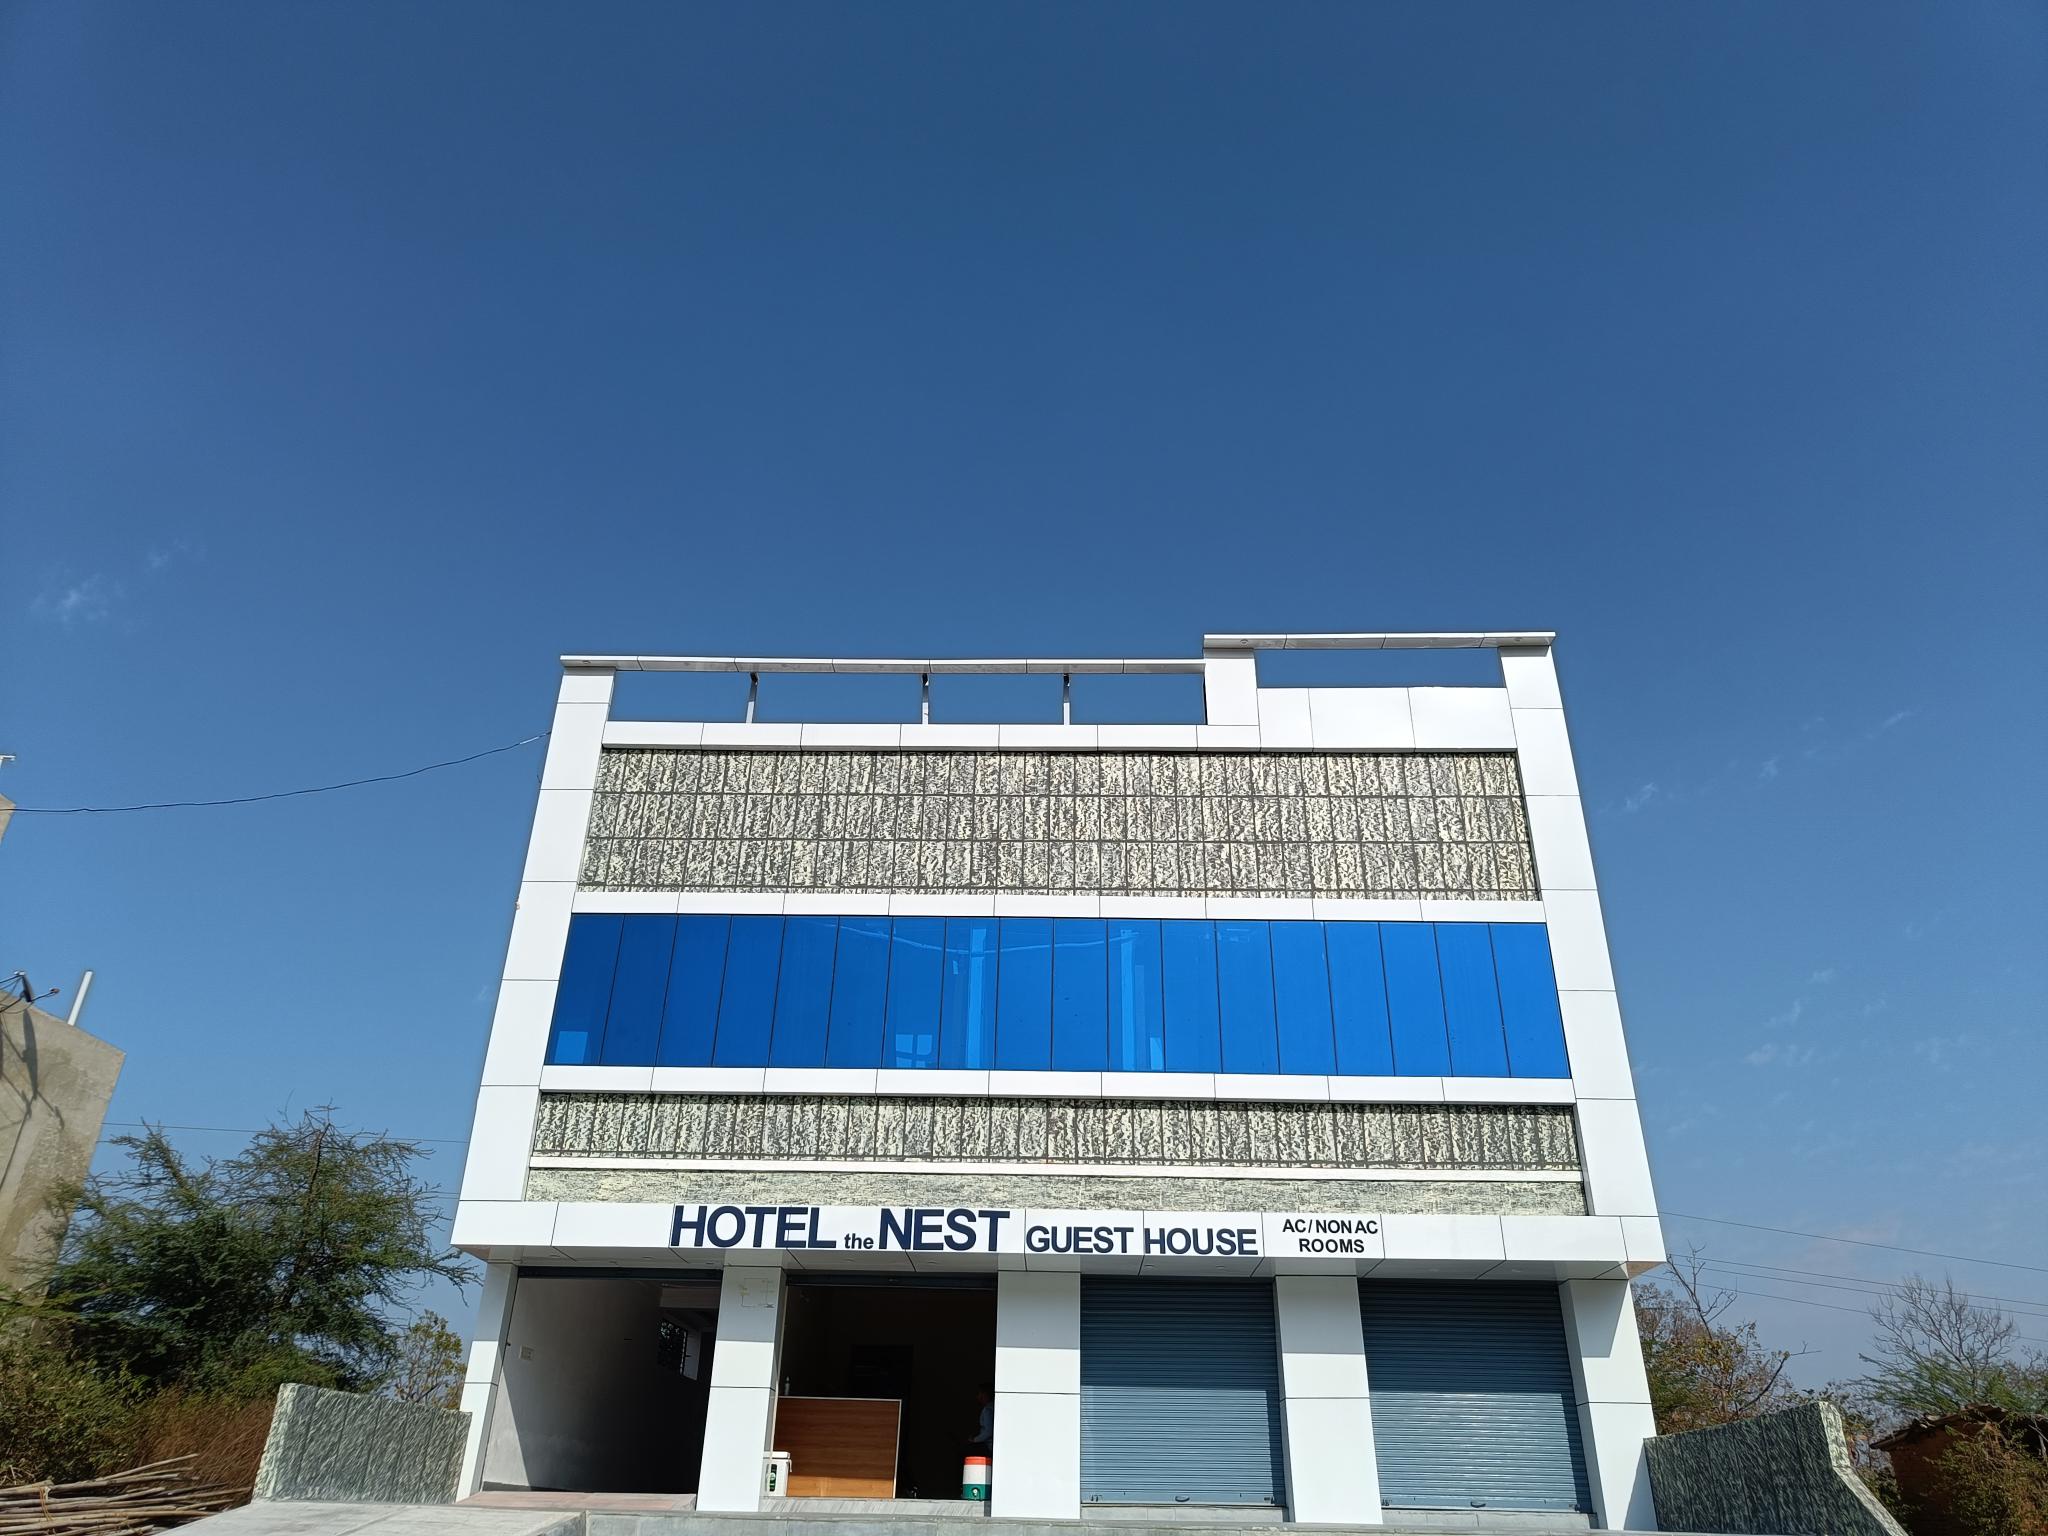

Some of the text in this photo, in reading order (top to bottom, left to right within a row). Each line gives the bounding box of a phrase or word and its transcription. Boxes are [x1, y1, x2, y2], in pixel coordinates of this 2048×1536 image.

[670, 1205, 1259, 1256] HOTEL the NEST GUEST HOUSE
[1298, 1238, 1365, 1254] ROOMS
